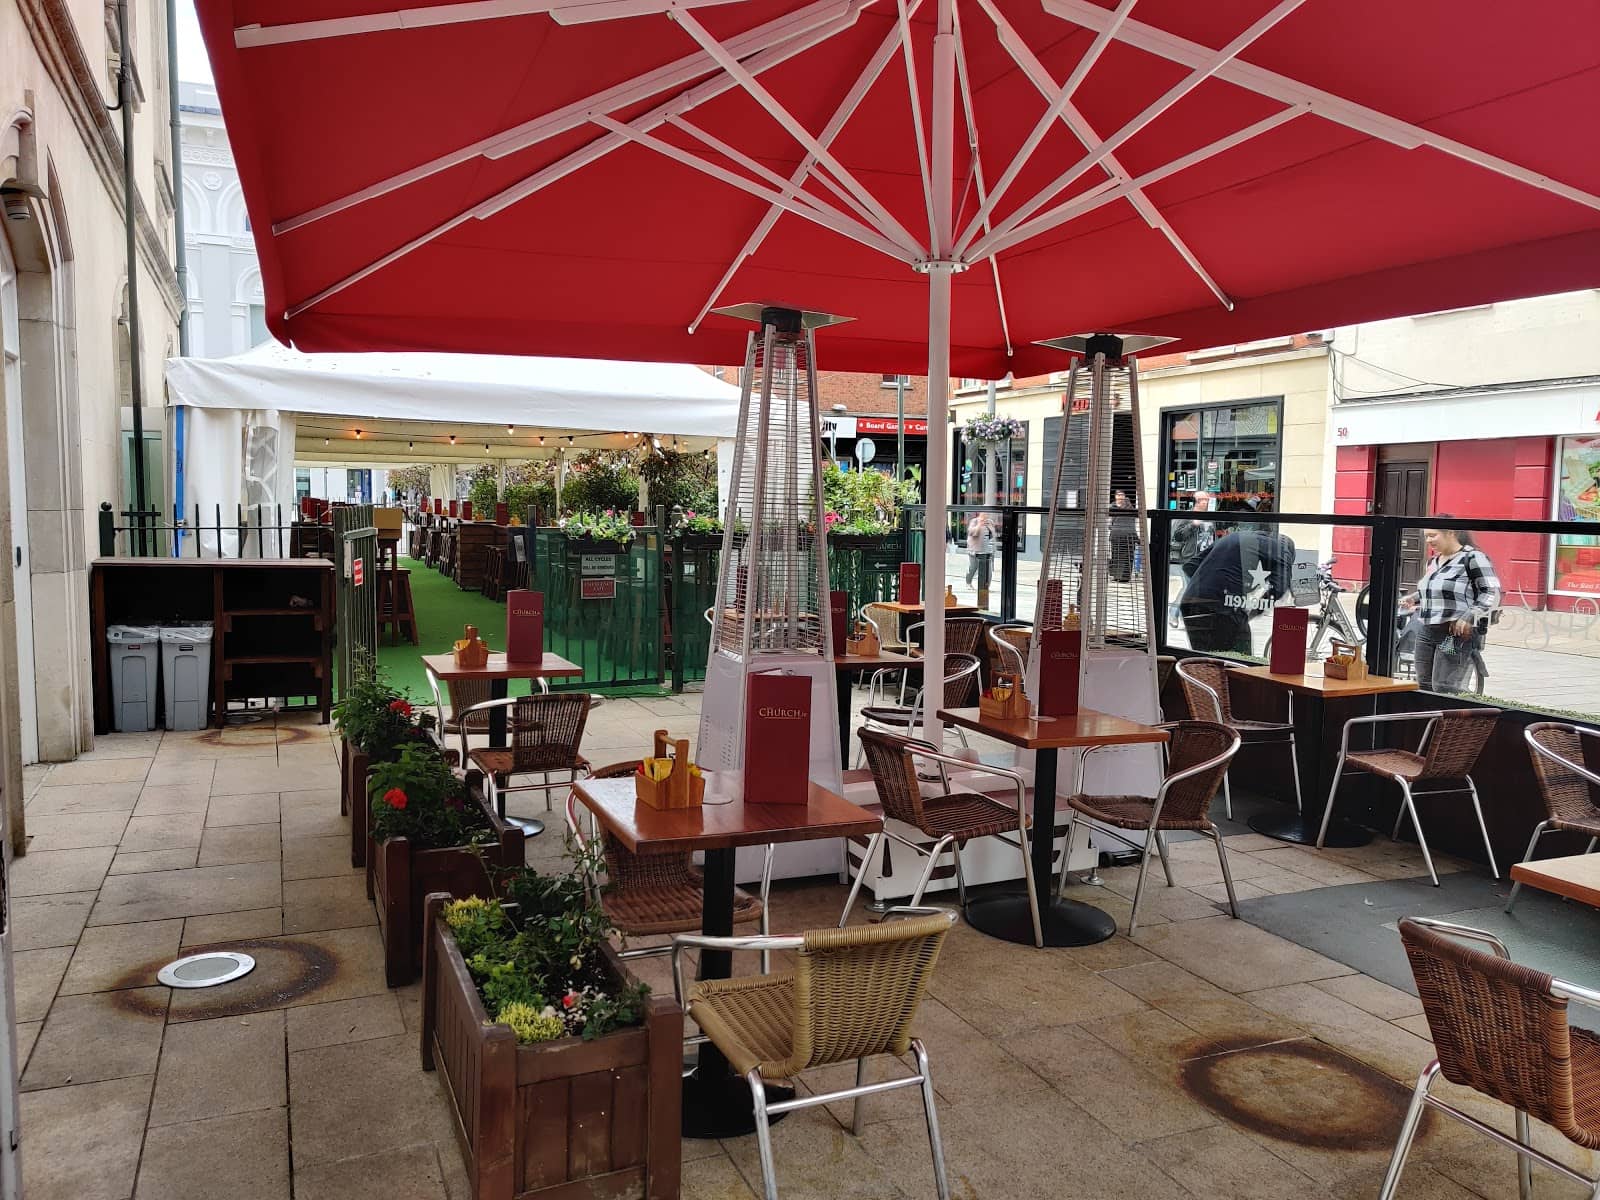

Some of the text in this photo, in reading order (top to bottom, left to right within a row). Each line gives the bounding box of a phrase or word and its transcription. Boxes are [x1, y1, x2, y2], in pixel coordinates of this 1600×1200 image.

[866, 422, 885, 430] Board
[1336, 427, 1348, 437] 50
[759, 706, 801, 718] CHURCH
